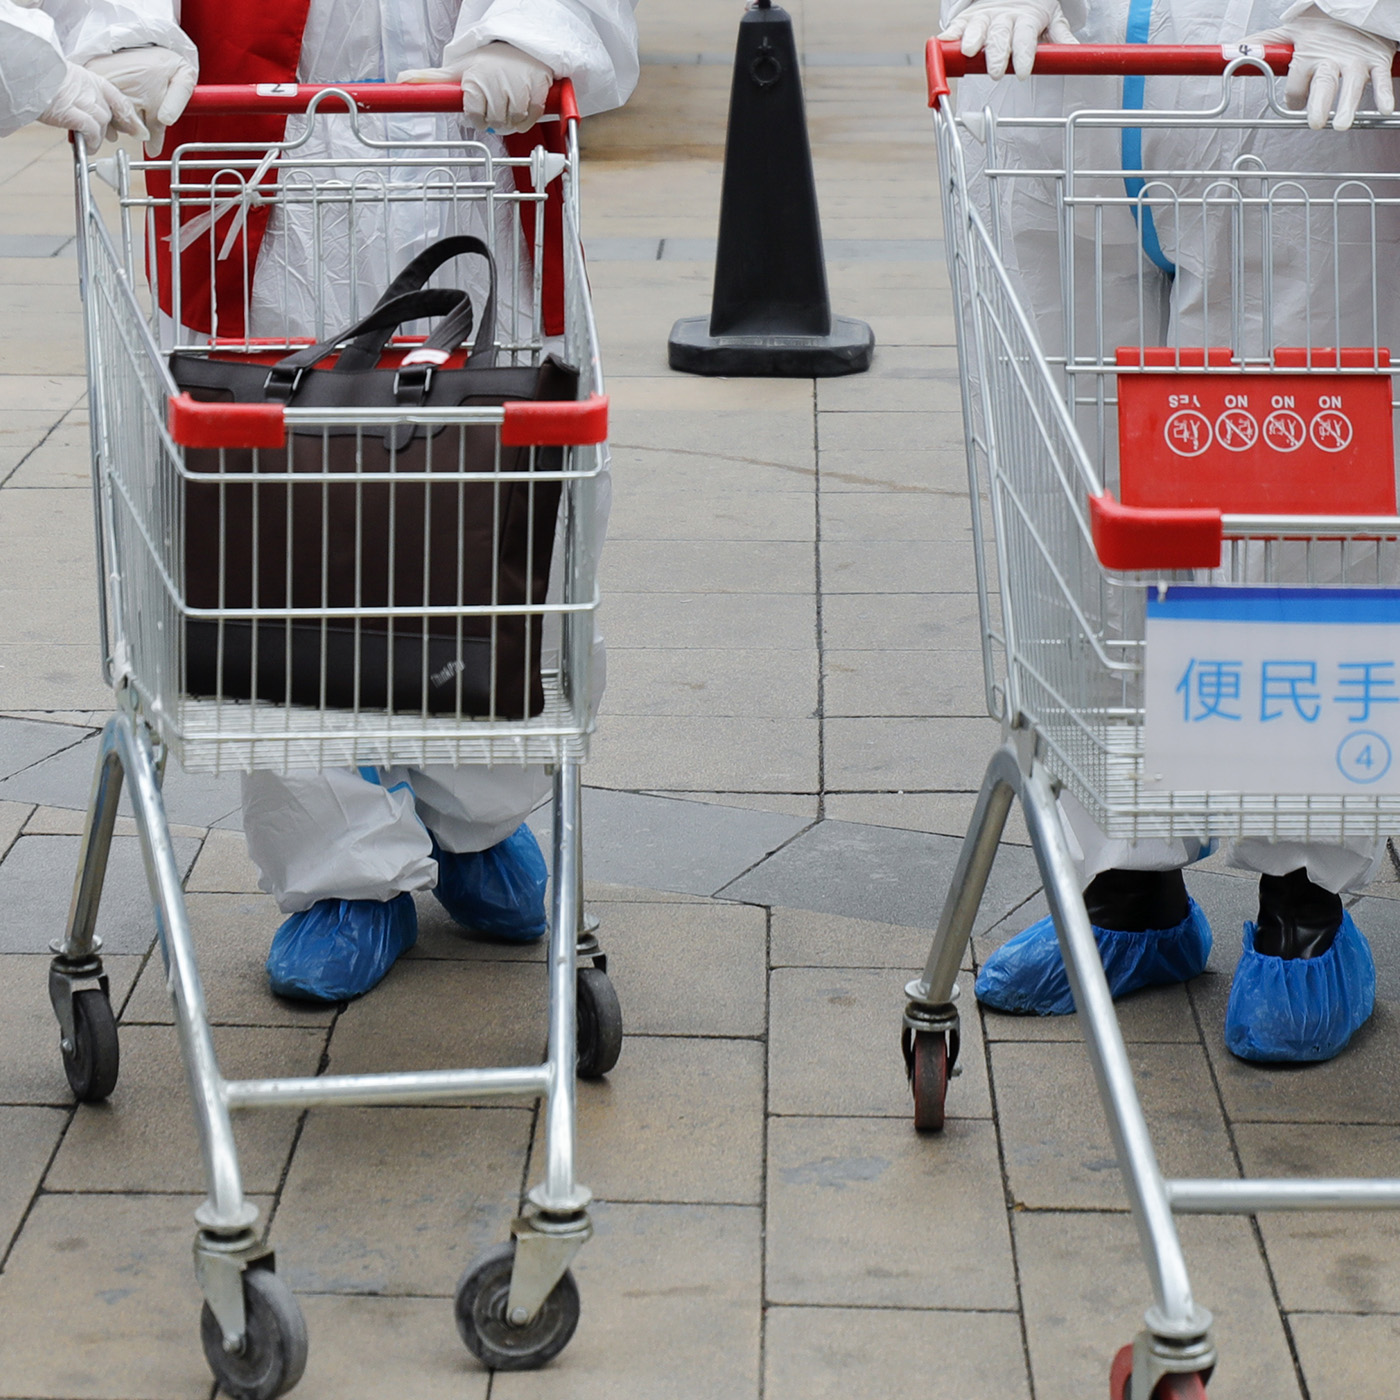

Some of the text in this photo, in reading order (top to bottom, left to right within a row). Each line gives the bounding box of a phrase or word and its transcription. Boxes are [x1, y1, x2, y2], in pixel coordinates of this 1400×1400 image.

[1224, 395, 1248, 408] NO
[1271, 396, 1295, 409] NO
[1318, 396, 1342, 409] NO
